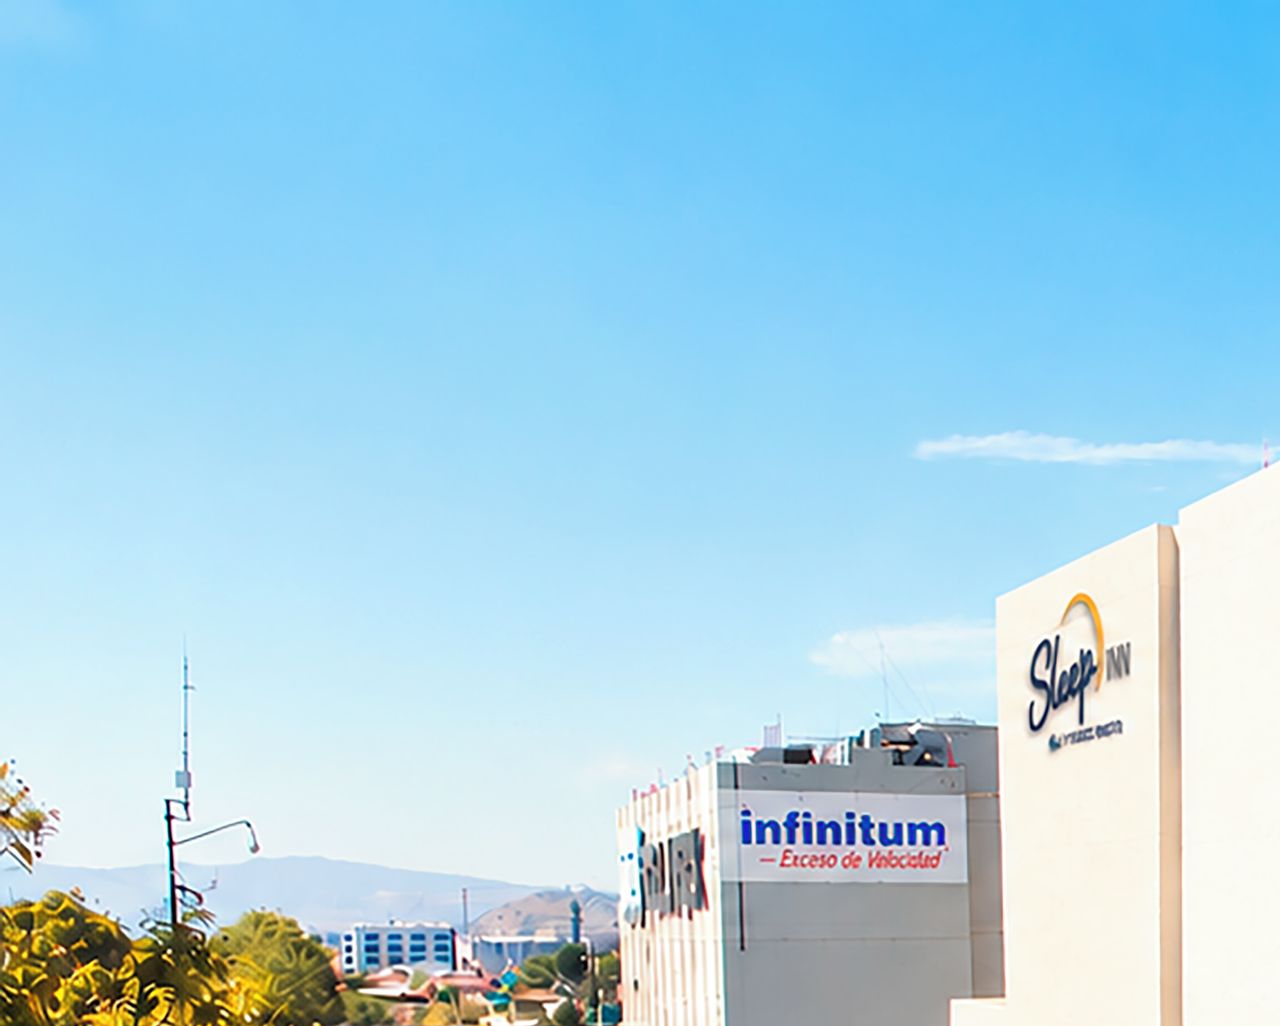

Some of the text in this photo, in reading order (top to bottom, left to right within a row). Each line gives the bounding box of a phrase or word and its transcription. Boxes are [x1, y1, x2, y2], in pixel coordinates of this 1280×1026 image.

[1028, 634, 1098, 732] Sleep
[740, 809, 946, 847] infinitum
[779, 849, 838, 868] Exceso
[841, 851, 862, 869] de
